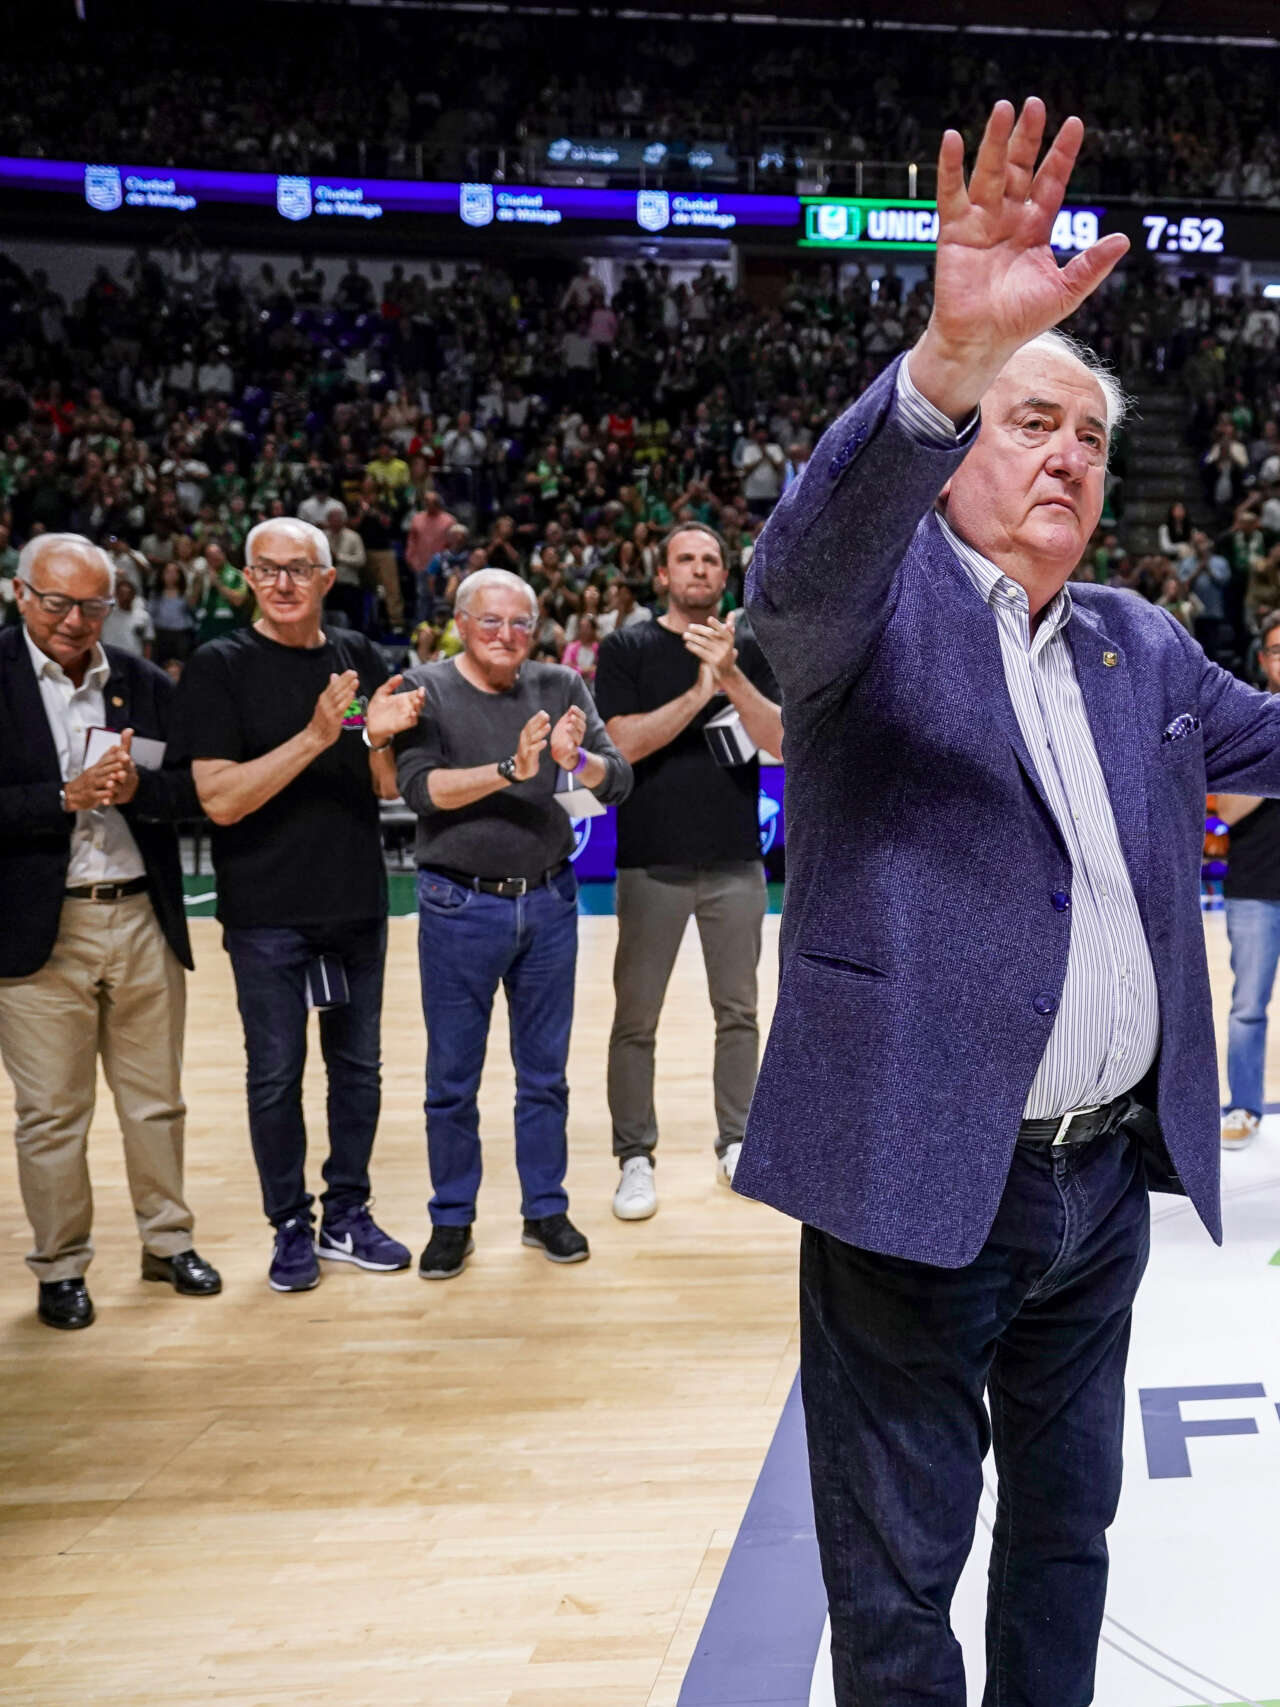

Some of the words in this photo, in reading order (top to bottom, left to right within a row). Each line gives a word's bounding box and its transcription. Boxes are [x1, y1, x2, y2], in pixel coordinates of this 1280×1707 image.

[125, 176, 175, 192] Ciudad
[125, 192, 146, 206] de
[314, 185, 363, 201] Ciudad
[496, 192, 543, 208] Ciudad
[314, 201, 333, 215] de
[672, 197, 718, 212] Ciudad
[496, 207, 514, 221] de
[672, 211, 690, 226] de
[1050, 210, 1099, 250] 49
[1143, 216, 1224, 252] 7:52
